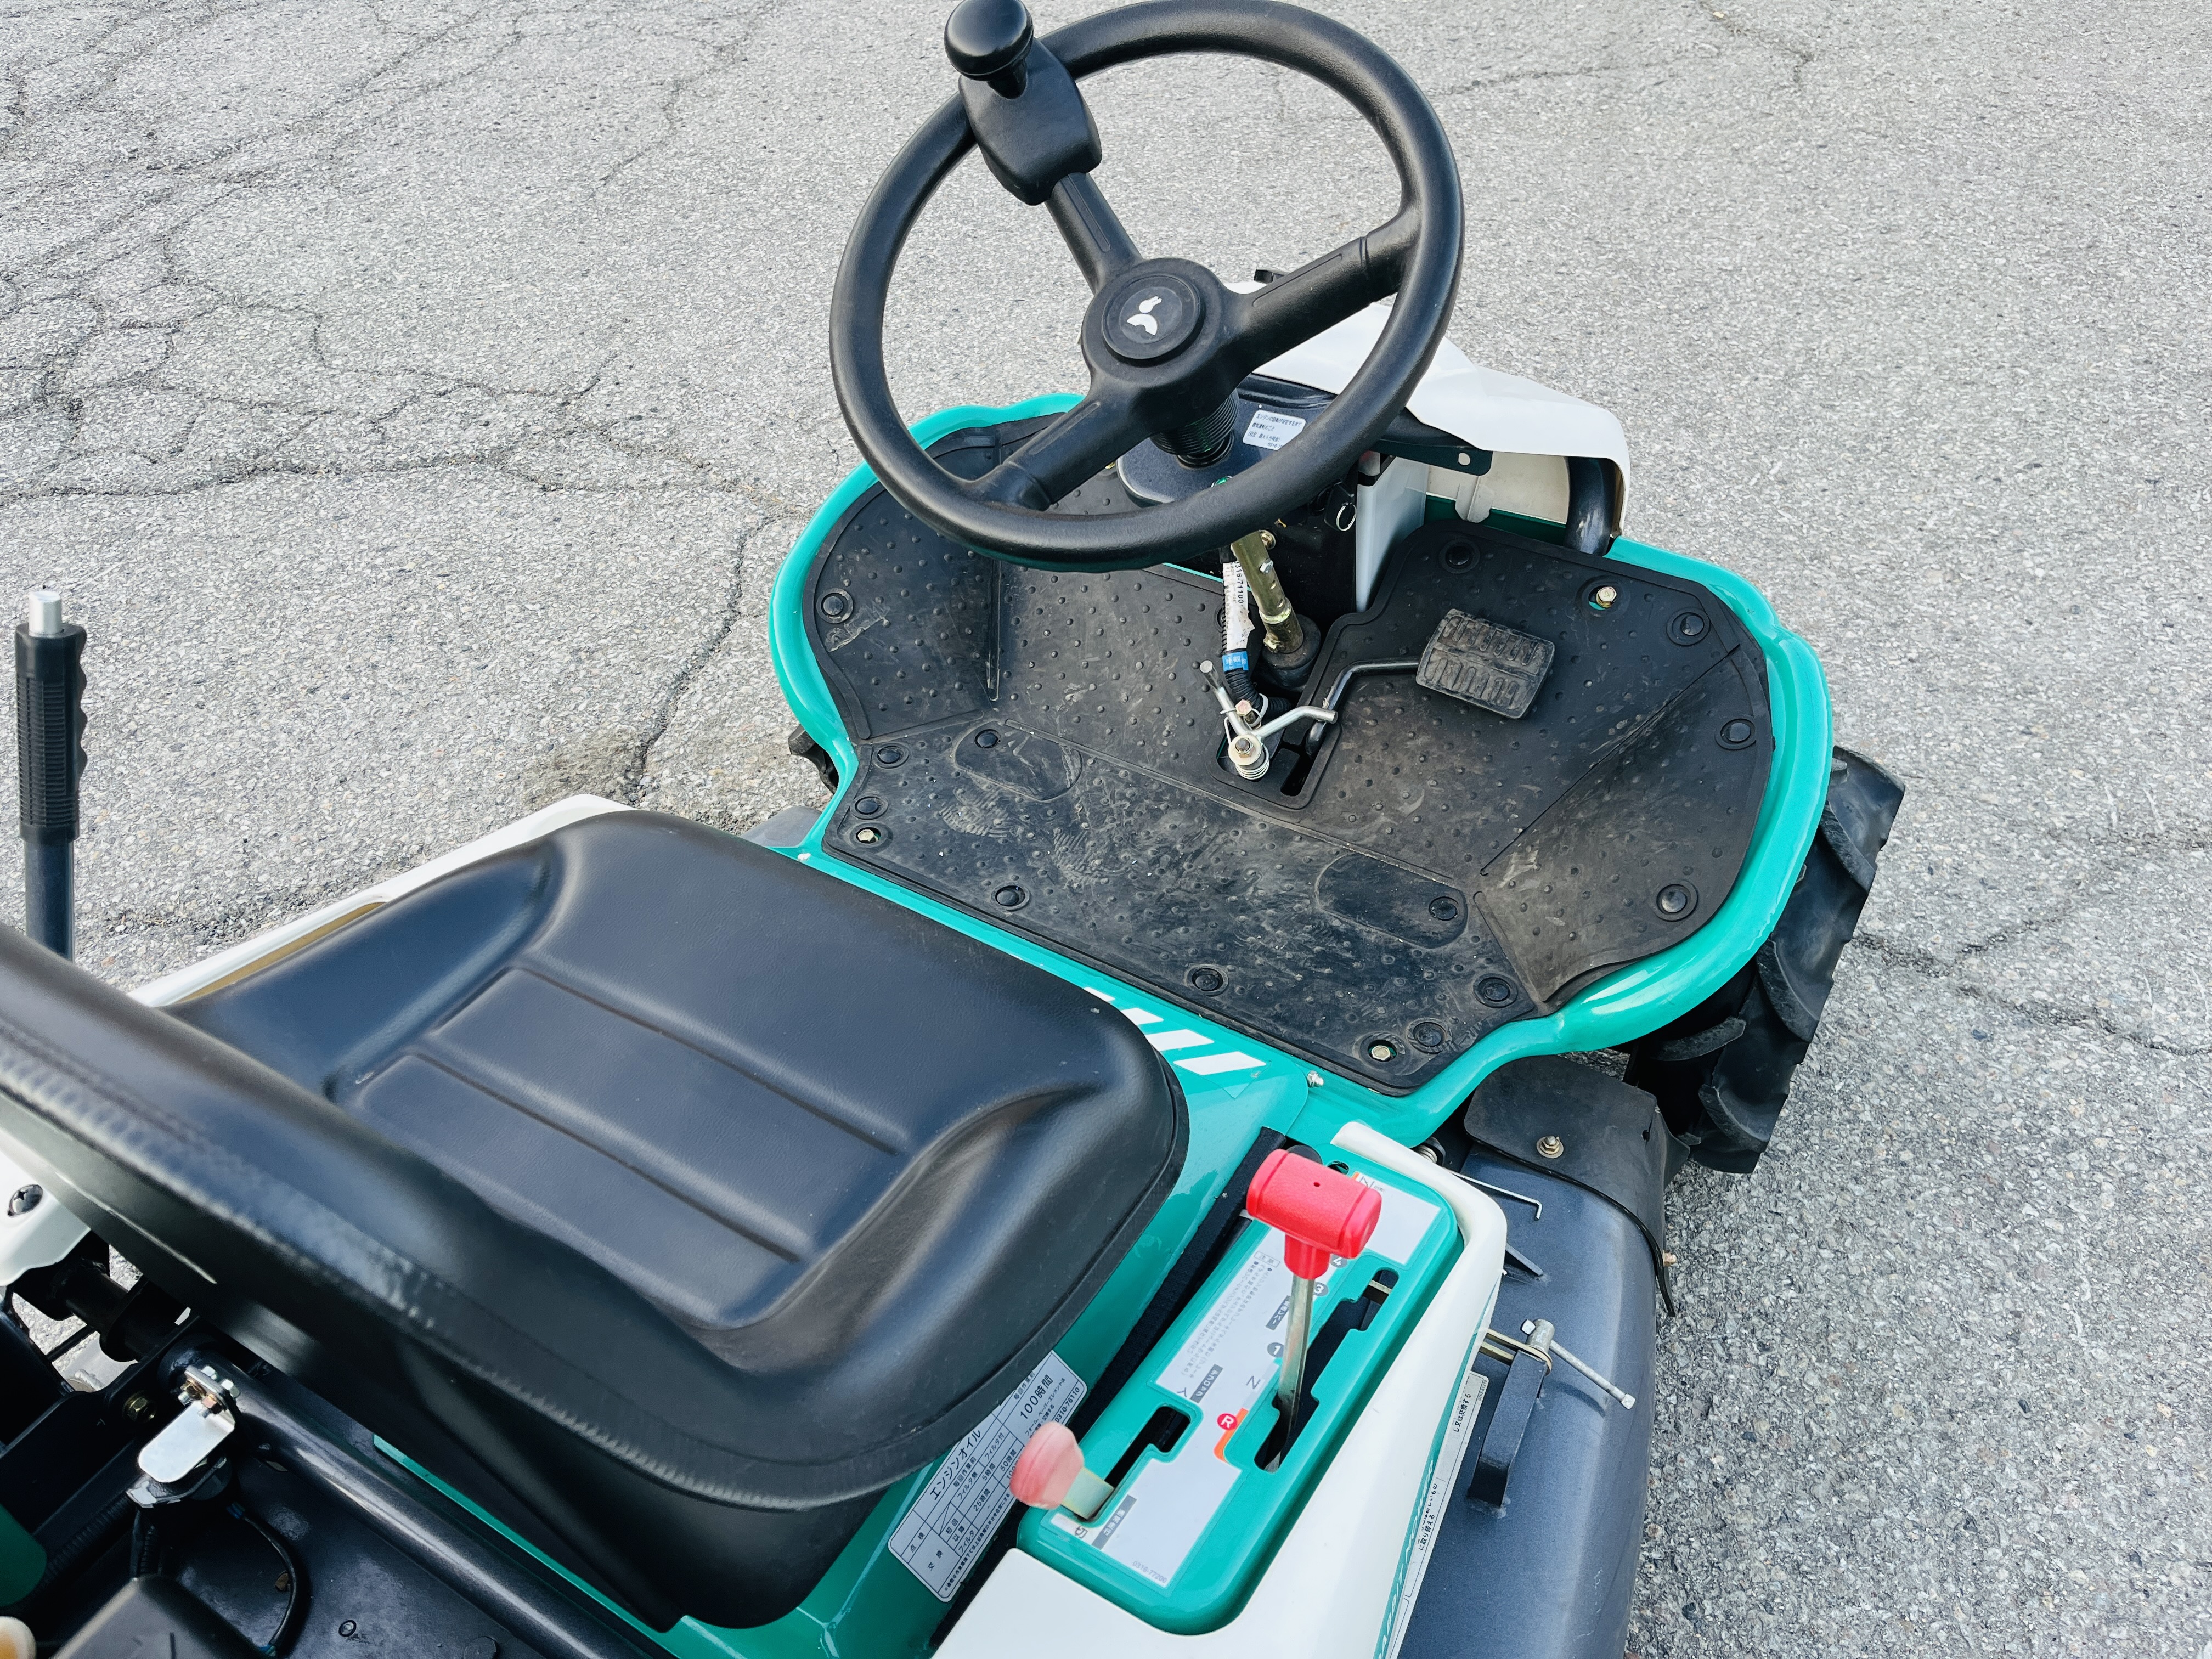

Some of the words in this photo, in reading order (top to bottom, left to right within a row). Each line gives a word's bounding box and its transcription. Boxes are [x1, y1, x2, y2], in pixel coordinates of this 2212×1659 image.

[1333, 1256, 1342, 1266] 4
[1313, 1284, 1324, 1294] 3
[1273, 1345, 1281, 1355] 1
[1245, 1375, 1261, 1389] N
[1019, 1374, 1054, 1420] 100時間
[1053, 1386, 1080, 1423] 0310-76110
[1221, 1415, 1234, 1429] R
[1452, 1392, 1471, 1432] し又は交換する
[928, 1427, 982, 1500] エンジンオイル
[952, 1455, 977, 1488] 毎回作業前
[956, 1470, 978, 1500] フィルタ無
[983, 1431, 1005, 1460] フィルタ付
[981, 1462, 996, 1481] 5時間
[972, 1487, 991, 1511] 25時間
[999, 1448, 1017, 1472] 50時間
[957, 1529, 976, 1554] フィルタ
[1073, 1525, 1088, 1539] 切
[1417, 1513, 1435, 1551] に取り替える
[1131, 1560, 1167, 1584] 0316-77200
